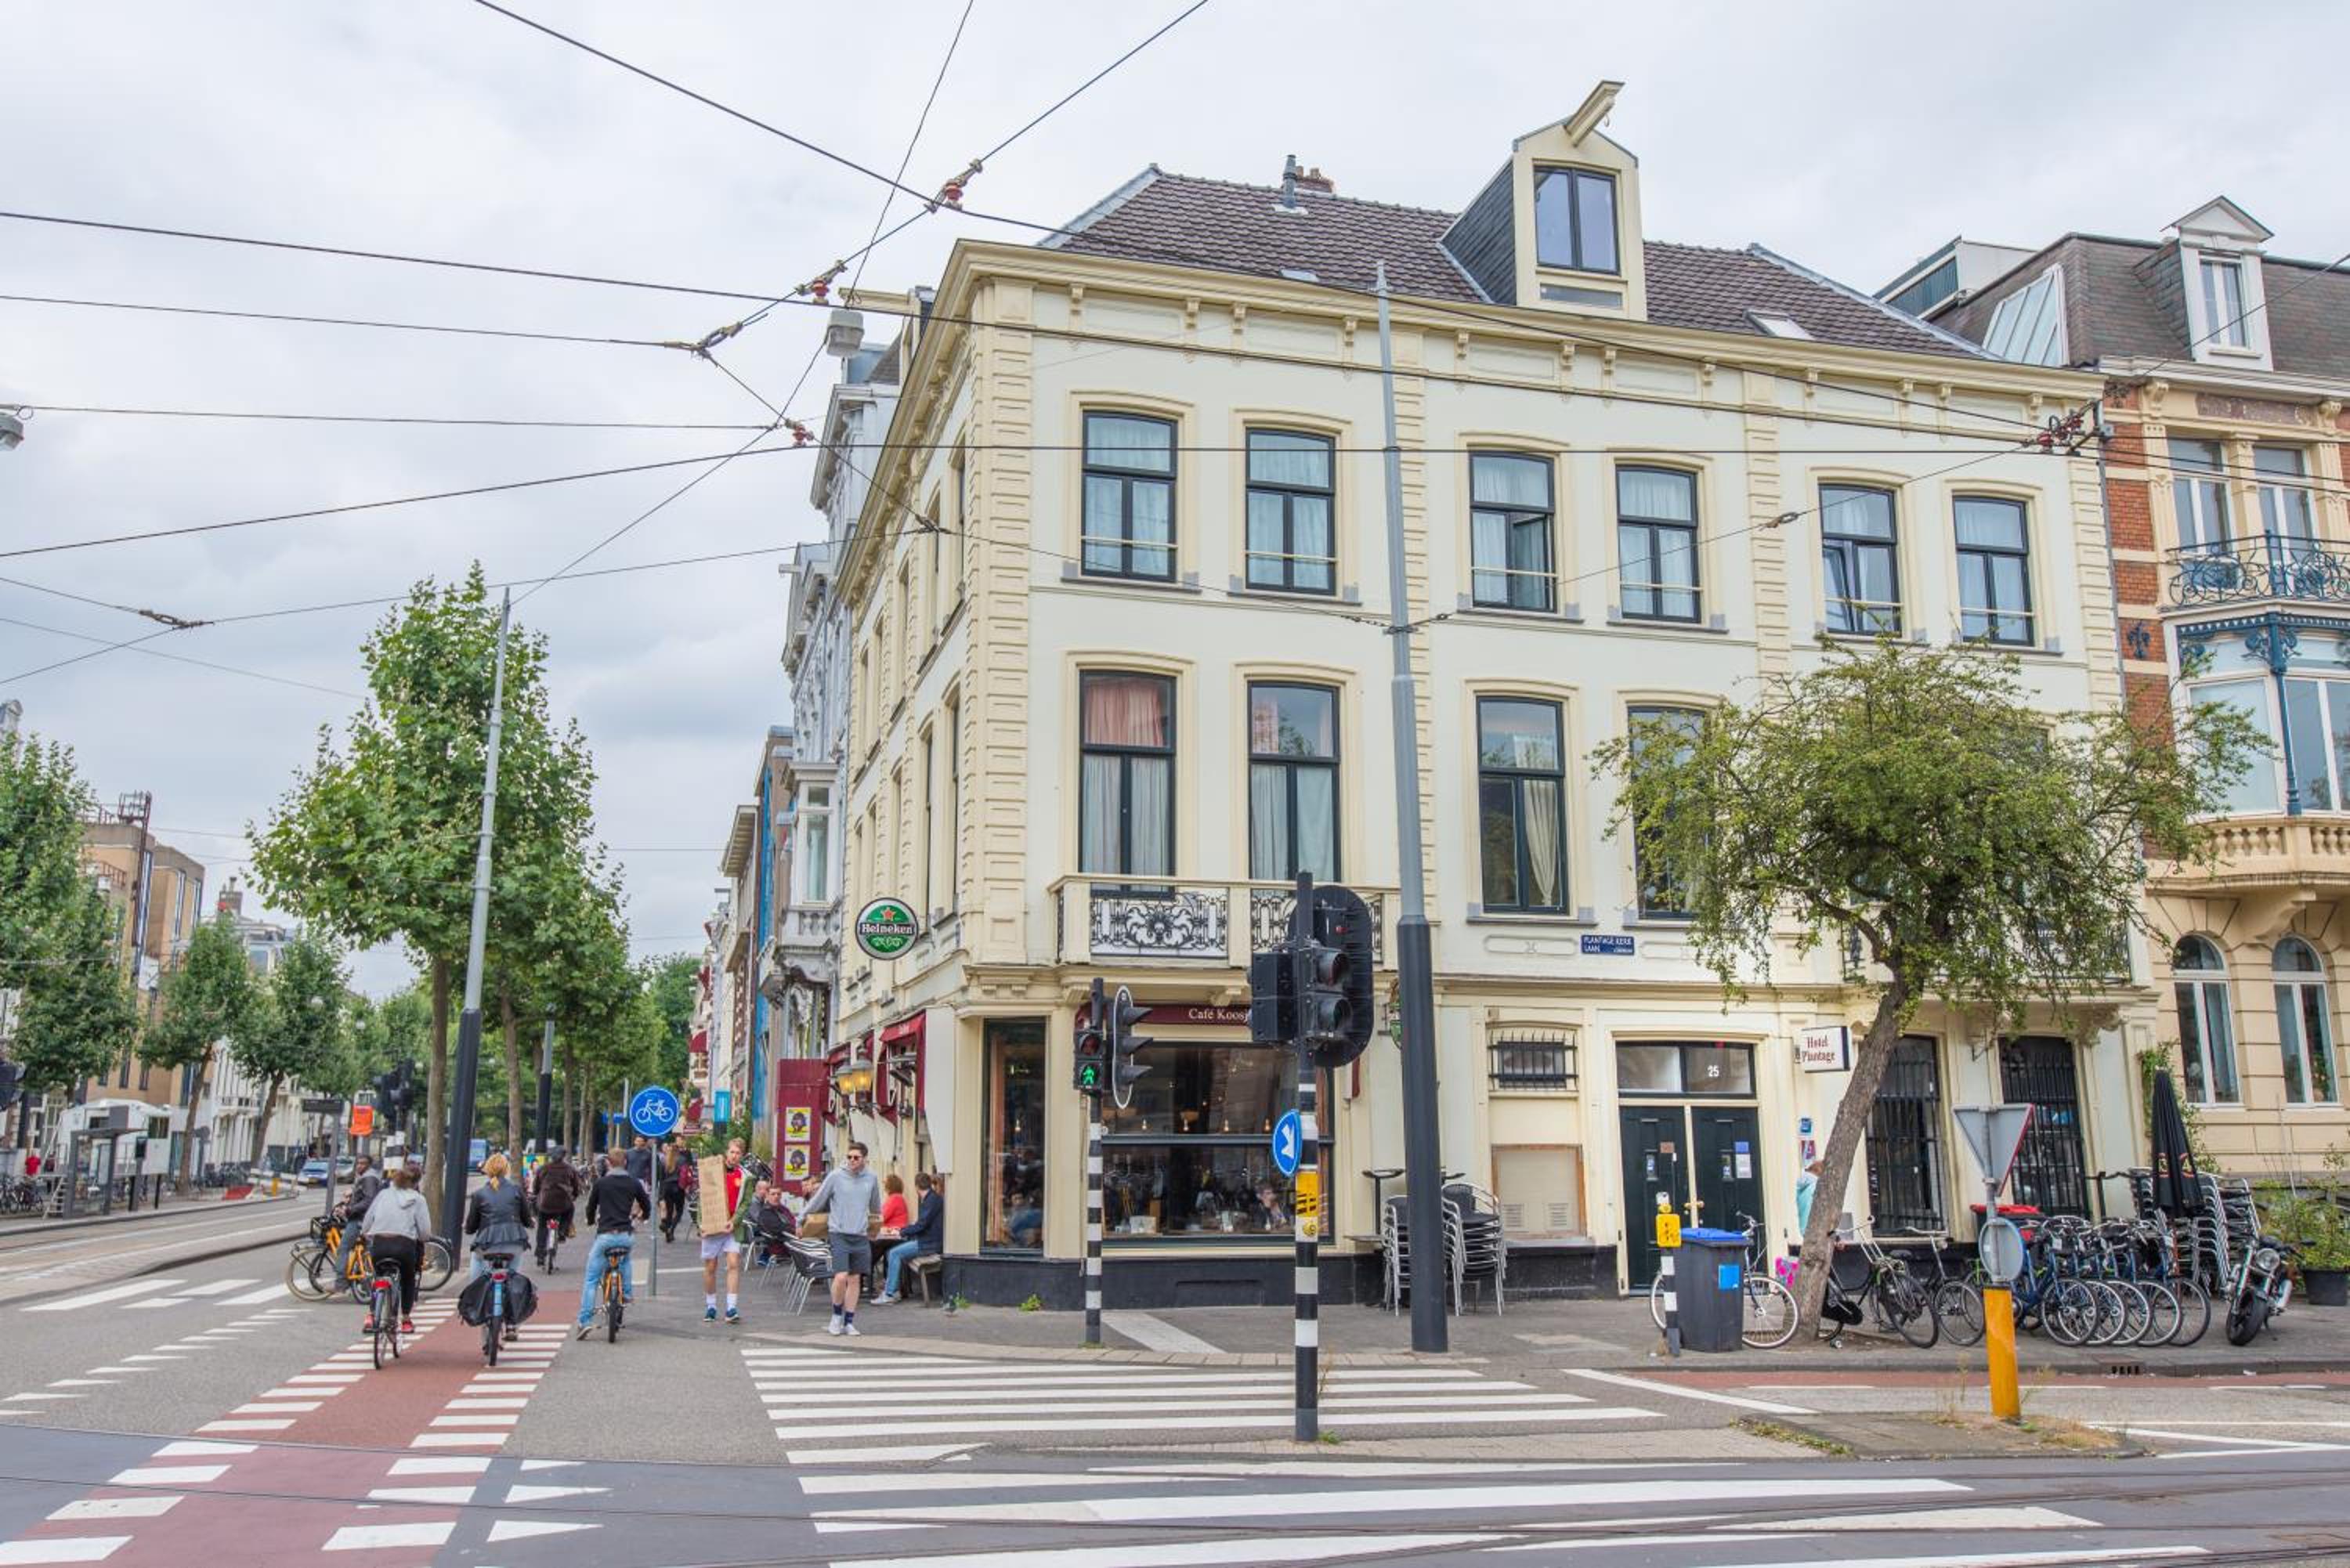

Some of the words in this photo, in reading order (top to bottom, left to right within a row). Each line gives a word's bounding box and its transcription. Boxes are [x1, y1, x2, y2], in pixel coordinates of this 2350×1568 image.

[862, 923, 913, 934] Heineken
[1188, 1008, 1214, 1019] Café
[1807, 1035, 1828, 1048] Hotel
[1707, 1064, 1719, 1077] 25
